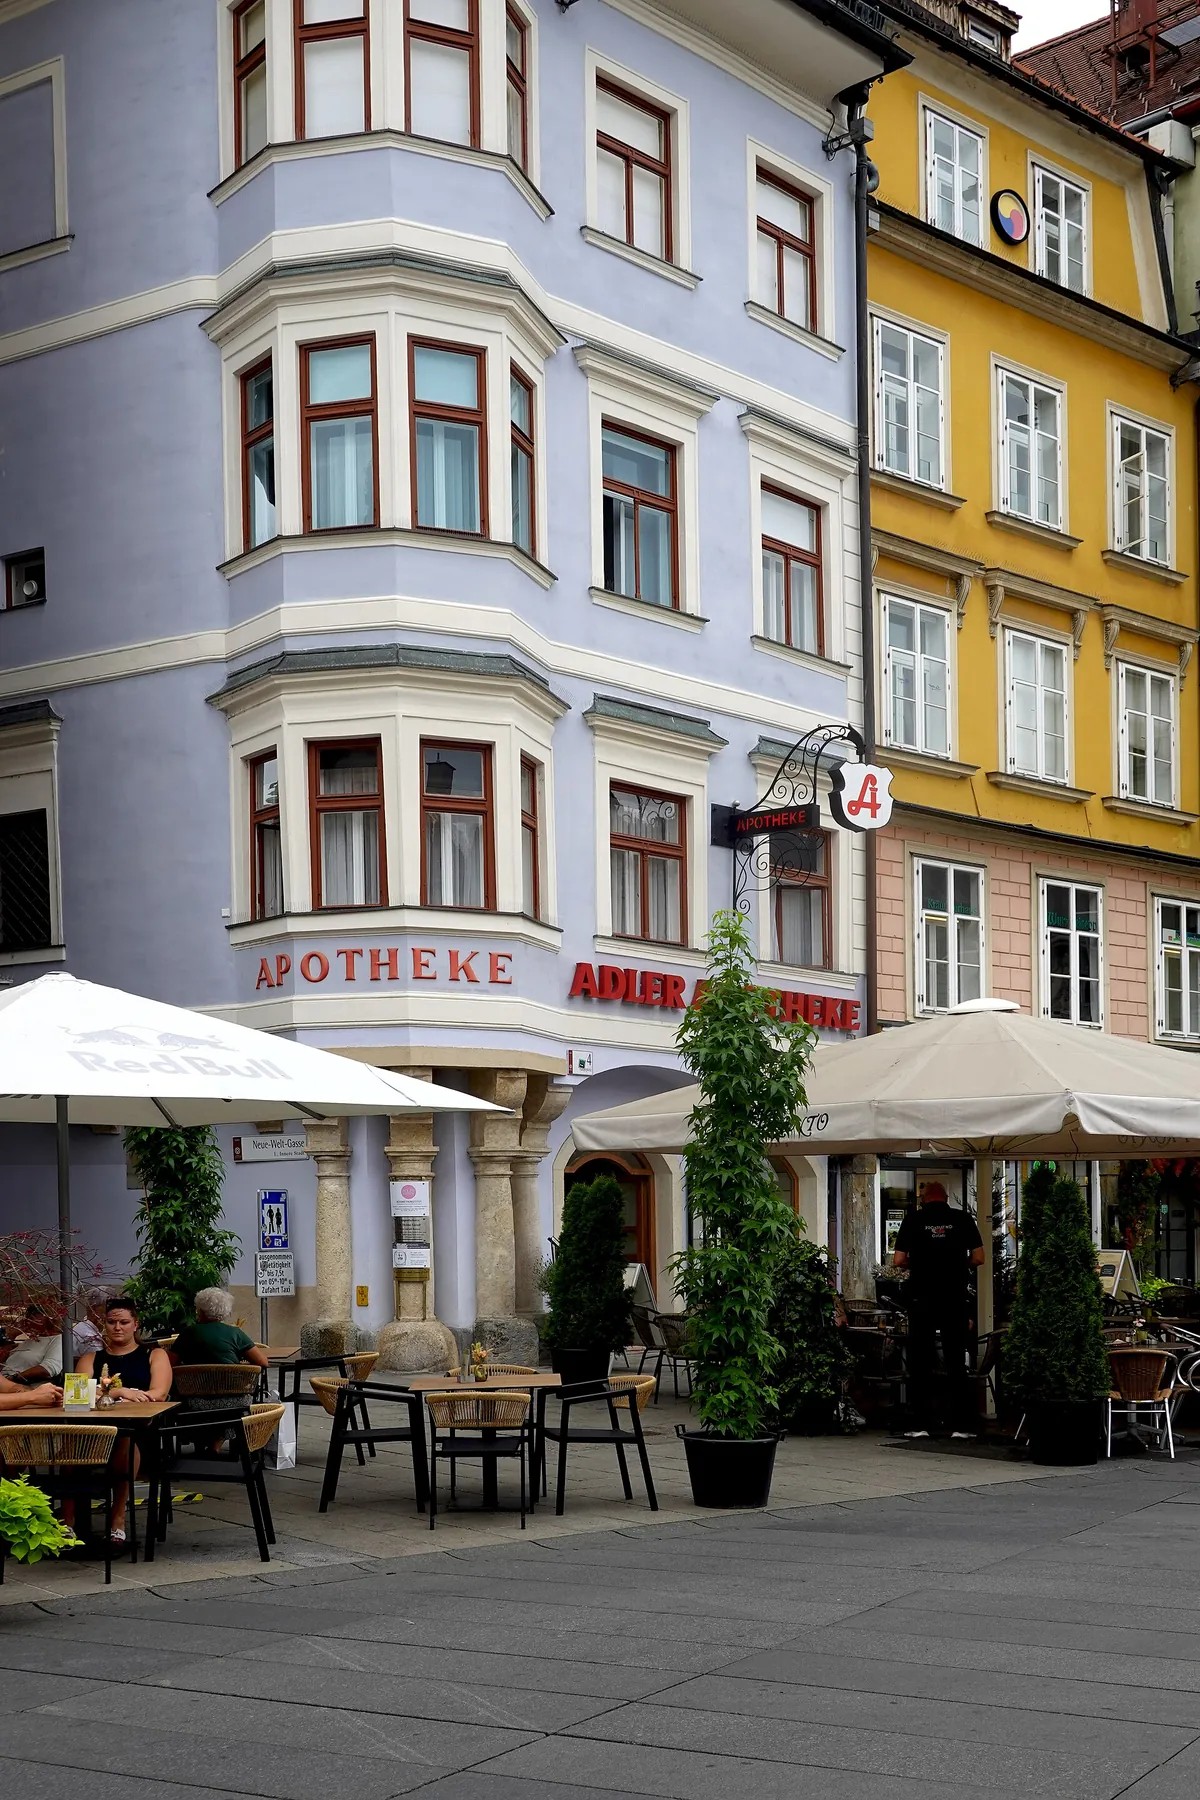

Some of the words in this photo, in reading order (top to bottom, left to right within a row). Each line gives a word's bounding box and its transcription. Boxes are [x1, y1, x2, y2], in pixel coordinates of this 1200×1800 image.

[736, 810, 806, 832] APOTHEKE
[255, 947, 513, 990] APOTHEKE
[569, 962, 686, 1008] ADLER
[67, 1051, 191, 1074] Red
[181, 1055, 293, 1080] Bull
[586, 1053, 592, 1066] 4
[252, 1138, 305, 1150] Neue-Welt-Gasse
[259, 1254, 292, 1262] ausgenommen
[275, 1270, 285, 1278] 7,5t
[261, 1286, 280, 1294] Zufahrt
[281, 1285, 291, 1293] Taxi
